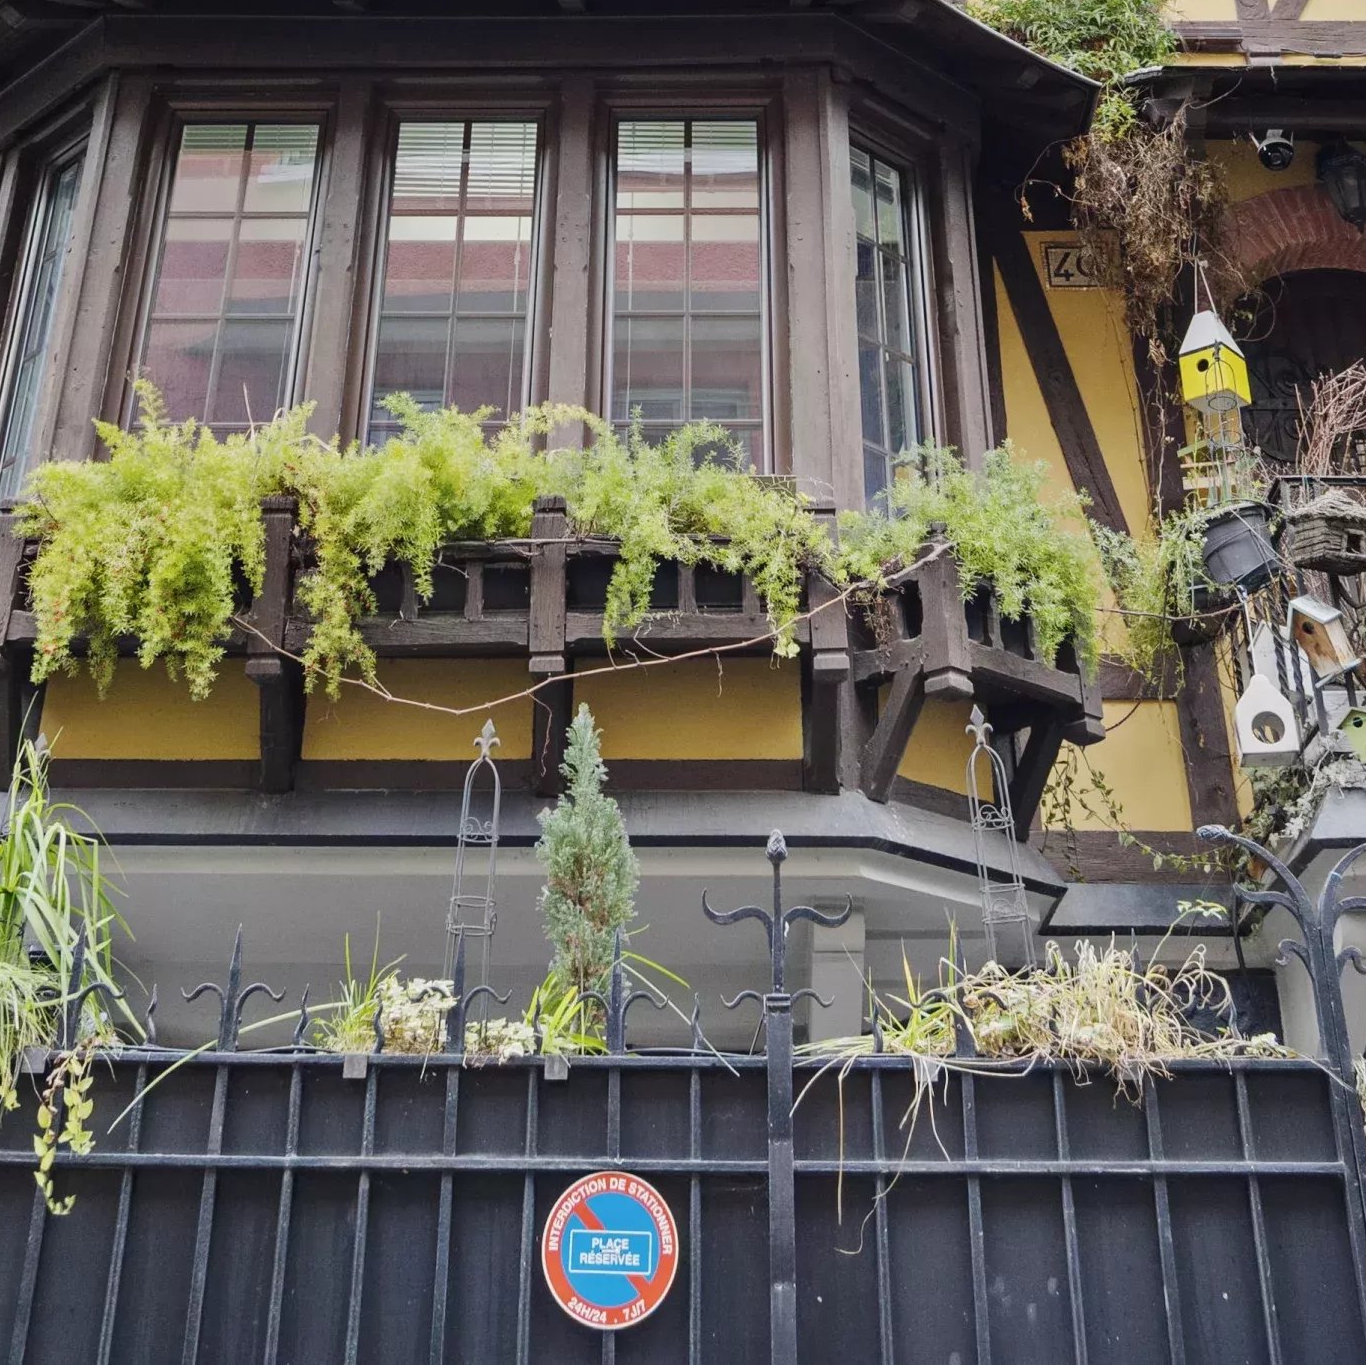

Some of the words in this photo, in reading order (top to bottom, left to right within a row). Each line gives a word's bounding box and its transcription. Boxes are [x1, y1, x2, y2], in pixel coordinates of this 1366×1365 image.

[548, 1177, 607, 1251] INTERDICTION
[609, 1177, 627, 1192] DE
[628, 1181, 673, 1255] STATIONNER
[591, 1237, 630, 1250] PLACE
[579, 1250, 641, 1266] RÉSERVÉE
[567, 1296, 607, 1324] 24H/24
